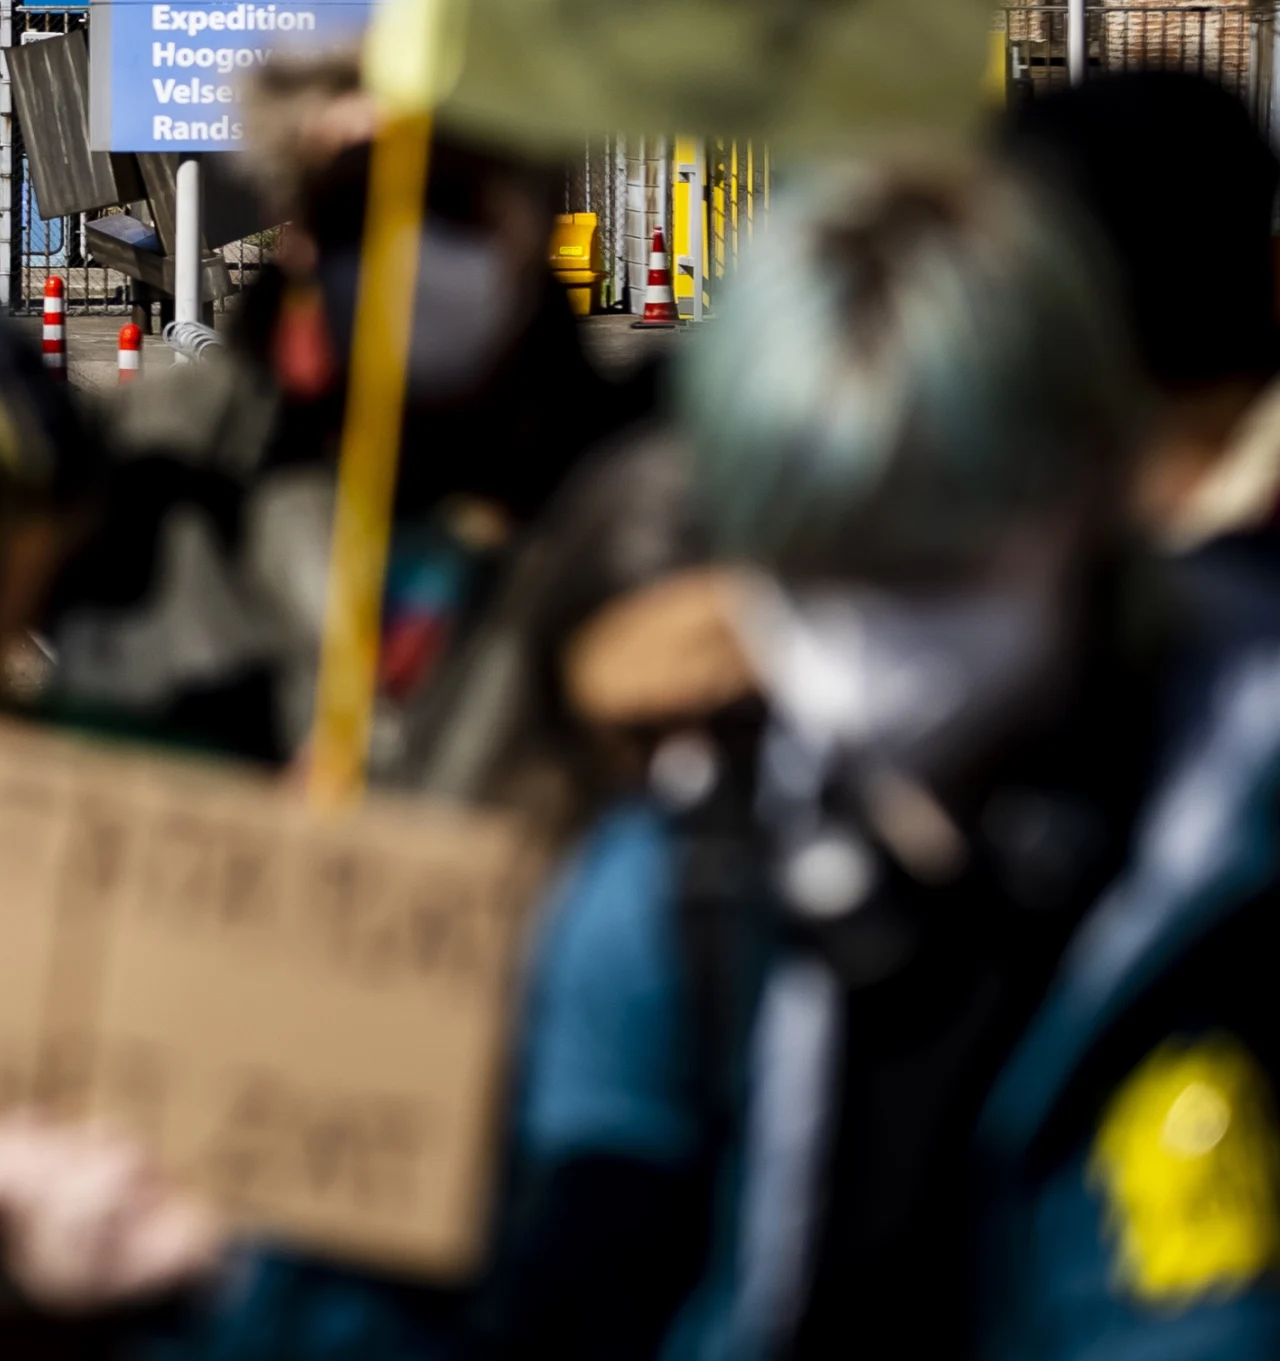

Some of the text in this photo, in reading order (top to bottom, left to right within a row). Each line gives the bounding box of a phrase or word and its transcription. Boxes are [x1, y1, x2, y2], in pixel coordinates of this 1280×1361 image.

[151, 3, 316, 36] Expedition
[151, 41, 273, 73] Hoogov
[152, 114, 244, 141] Rands
